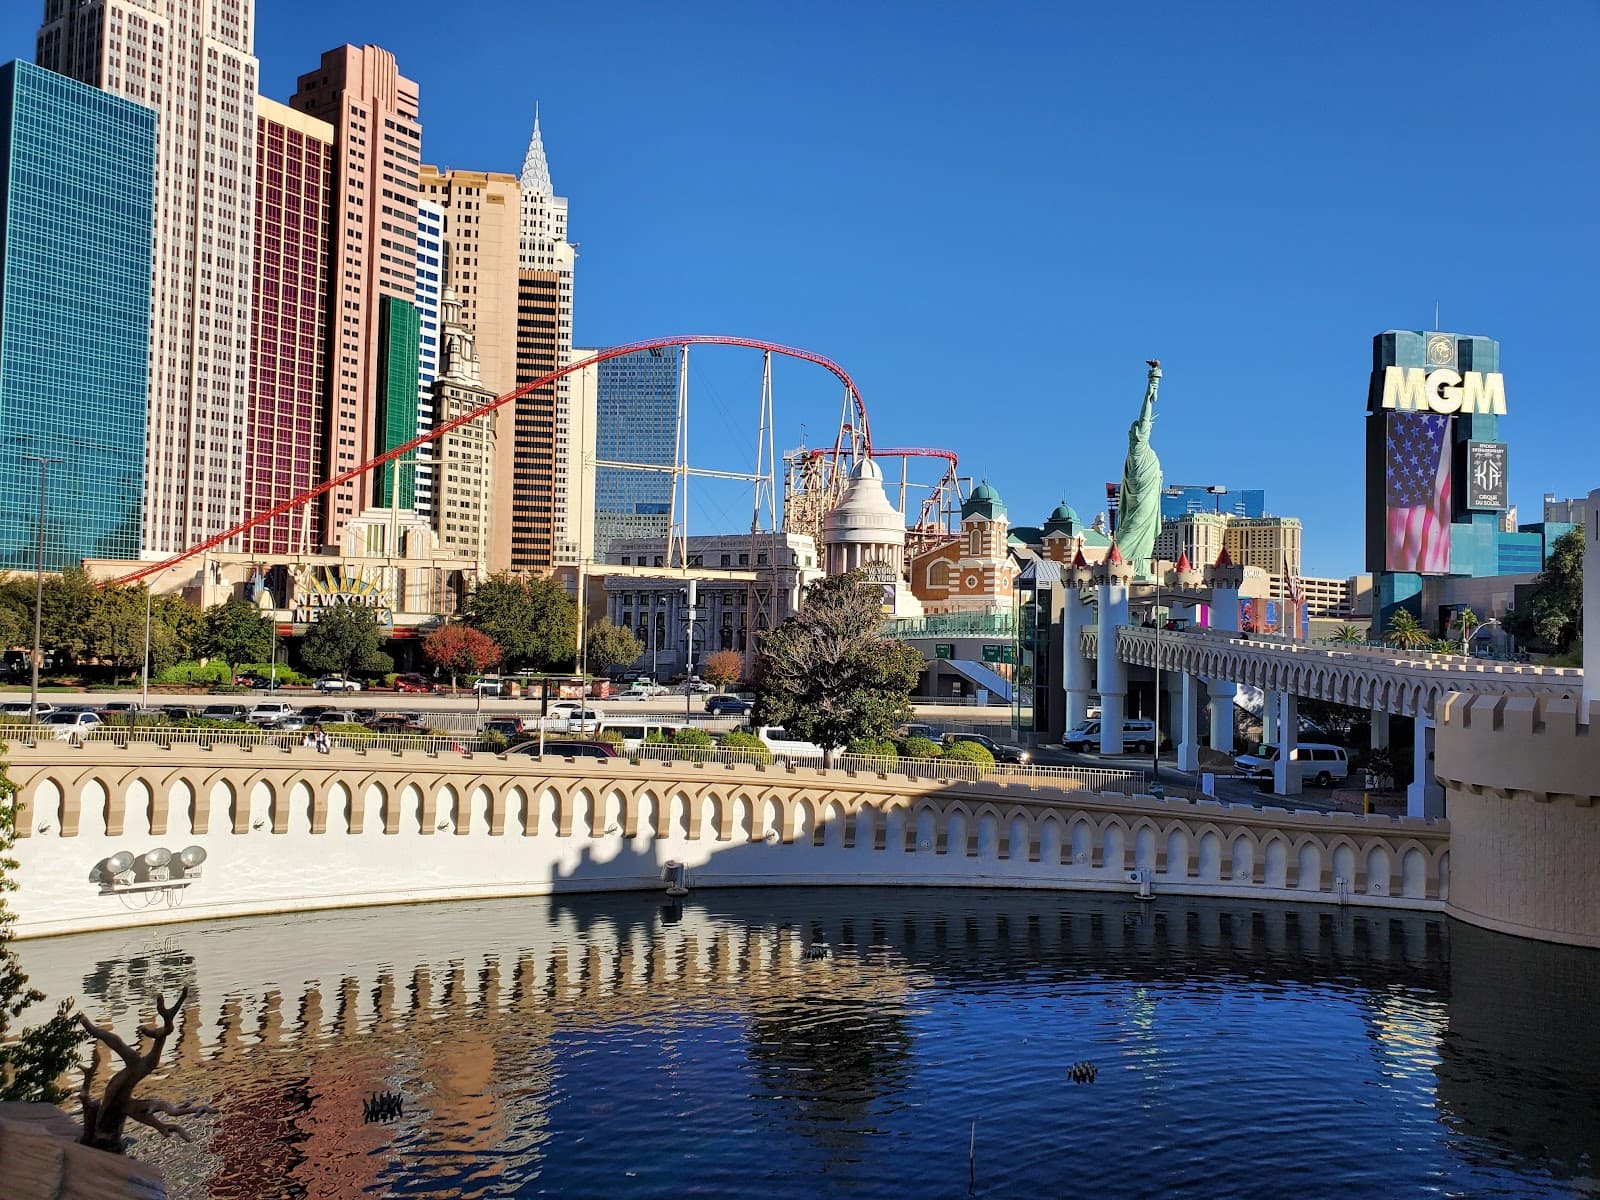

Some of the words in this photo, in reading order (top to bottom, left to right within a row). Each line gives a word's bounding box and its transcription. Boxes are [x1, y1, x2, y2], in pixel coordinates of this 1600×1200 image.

[1382, 366, 1507, 415] MGM
[297, 593, 335, 606] NEW
[341, 594, 387, 608] YORK
[296, 608, 331, 623] NE
